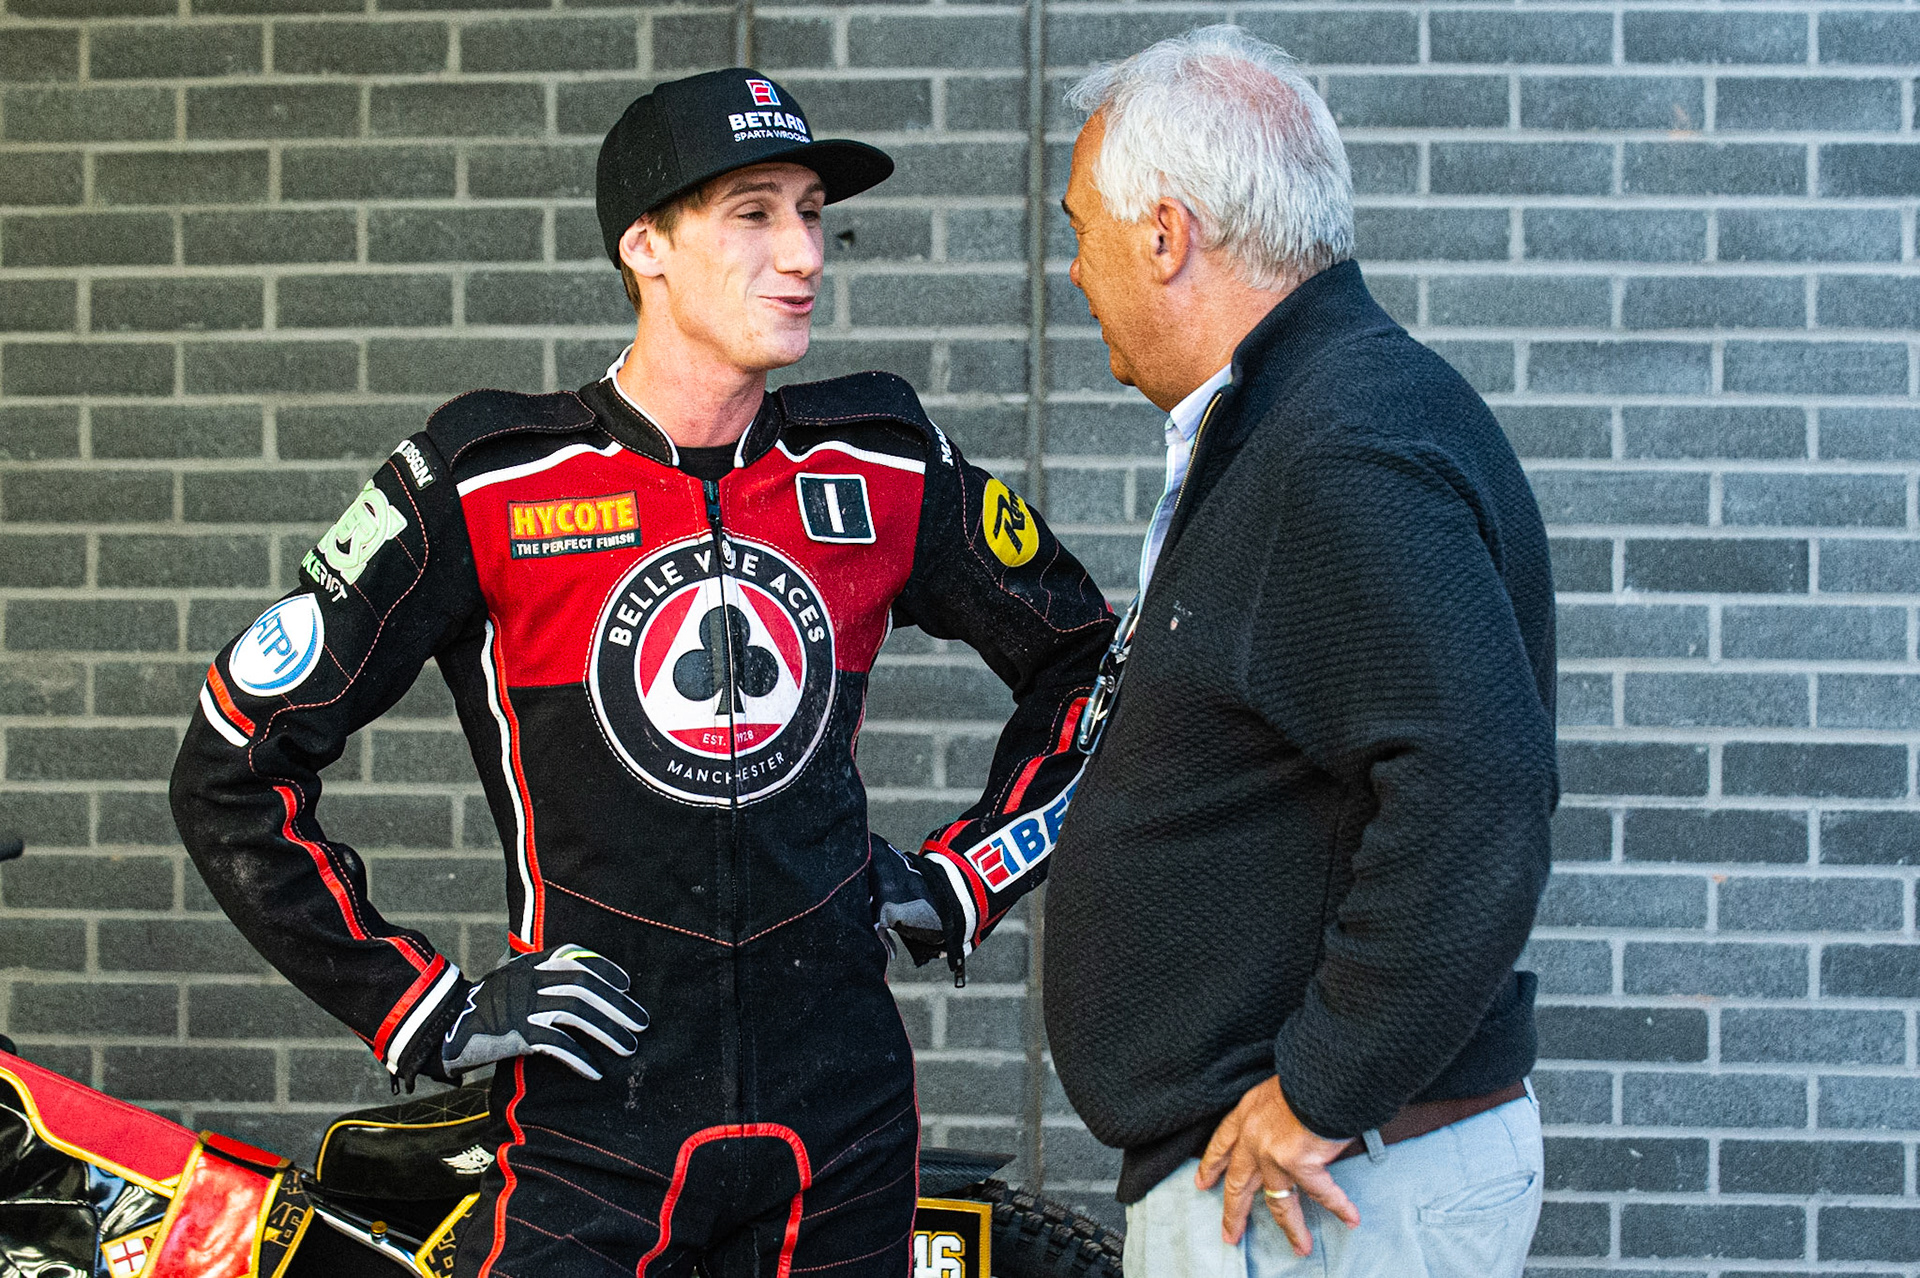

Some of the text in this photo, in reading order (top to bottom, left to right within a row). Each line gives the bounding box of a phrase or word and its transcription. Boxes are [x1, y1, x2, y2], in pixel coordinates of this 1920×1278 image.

[728, 111, 806, 134] BETARD
[734, 129, 773, 142] SPARTA
[513, 497, 635, 536] HYCOTE
[517, 532, 635, 556] THE PERFECT FINISH
[608, 561, 684, 647] BELLE
[769, 573, 826, 644] ACES
[256, 612, 298, 675] ATPI
[702, 730, 755, 746] EST. 1928
[667, 751, 785, 785] MANCHESTER
